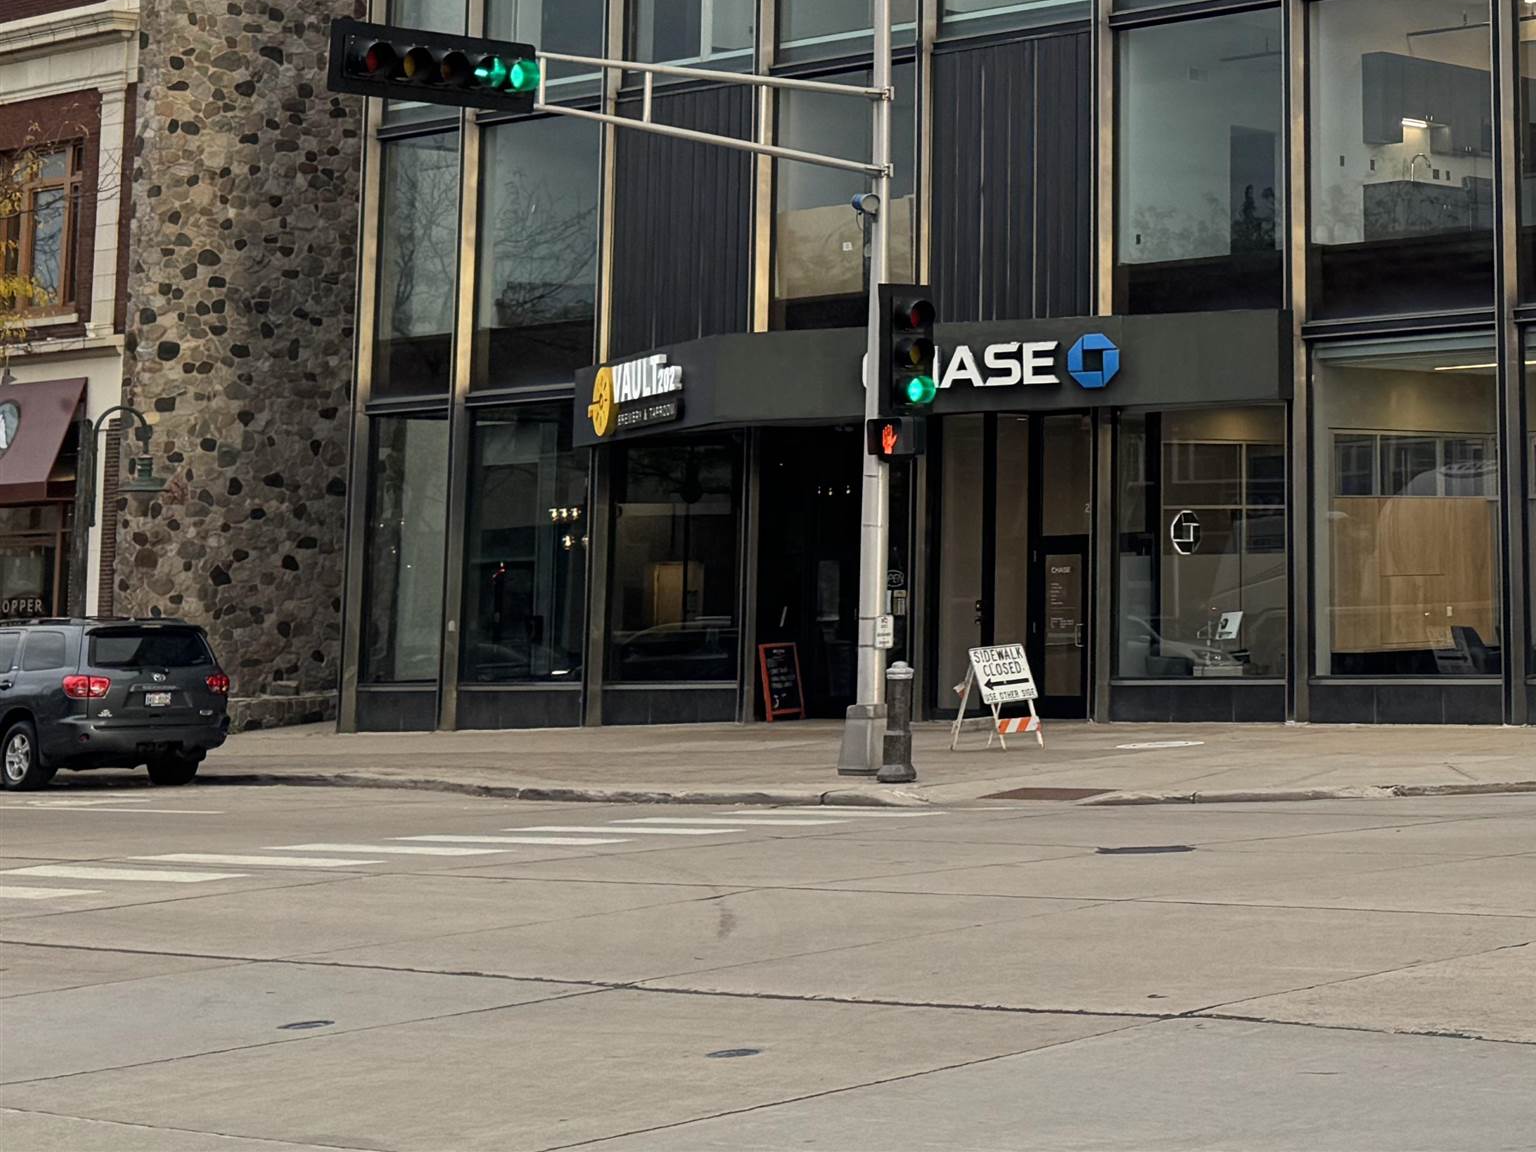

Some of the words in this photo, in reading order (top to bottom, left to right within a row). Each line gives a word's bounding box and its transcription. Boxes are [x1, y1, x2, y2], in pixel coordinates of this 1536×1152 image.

[862, 341, 1061, 389] ASE
[612, 354, 665, 403] VAULT
[657, 365, 682, 394] 202
[973, 647, 1024, 664] SIDEWALK
[982, 660, 1022, 677] CLOSED
[985, 692, 999, 702] USE
